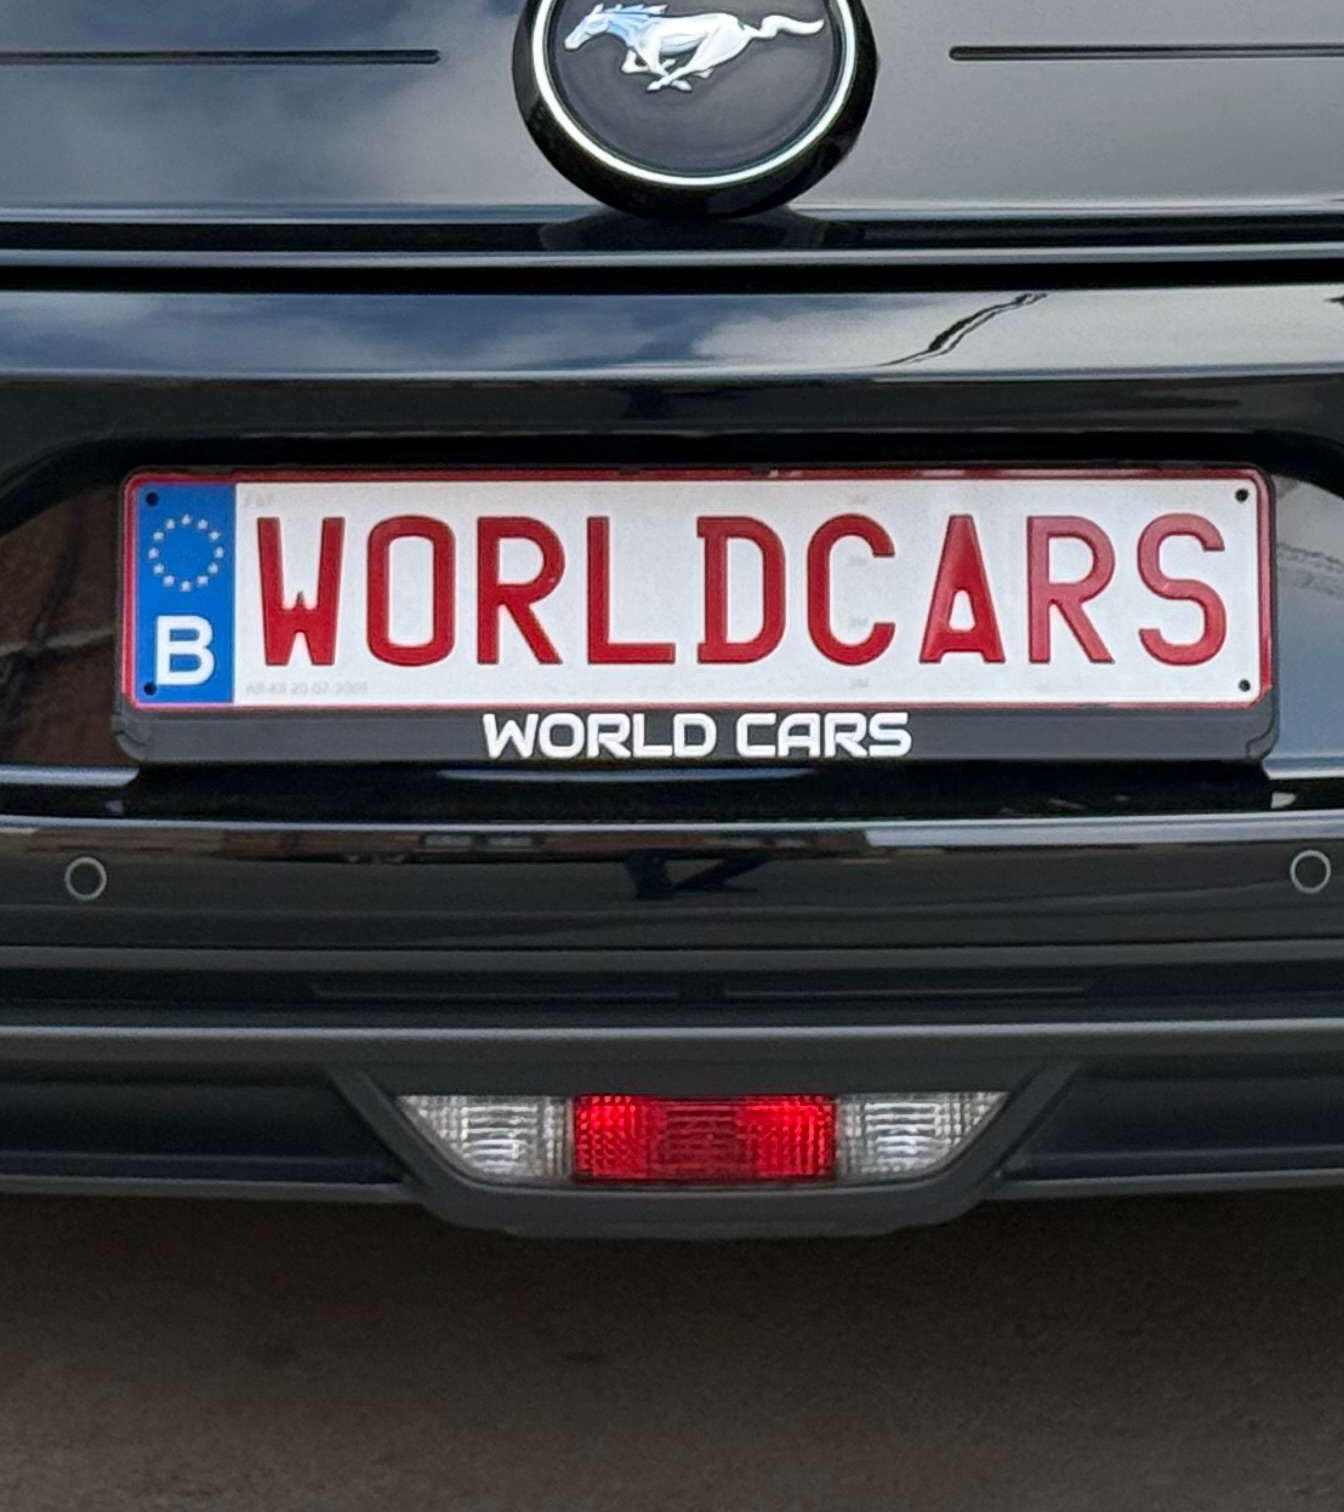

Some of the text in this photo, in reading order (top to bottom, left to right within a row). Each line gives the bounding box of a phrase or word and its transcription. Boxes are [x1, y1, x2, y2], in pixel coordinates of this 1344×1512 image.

[256, 514, 1229, 667] WORLDCARS
[154, 615, 216, 687] B
[482, 711, 914, 760] WORLD CARS
